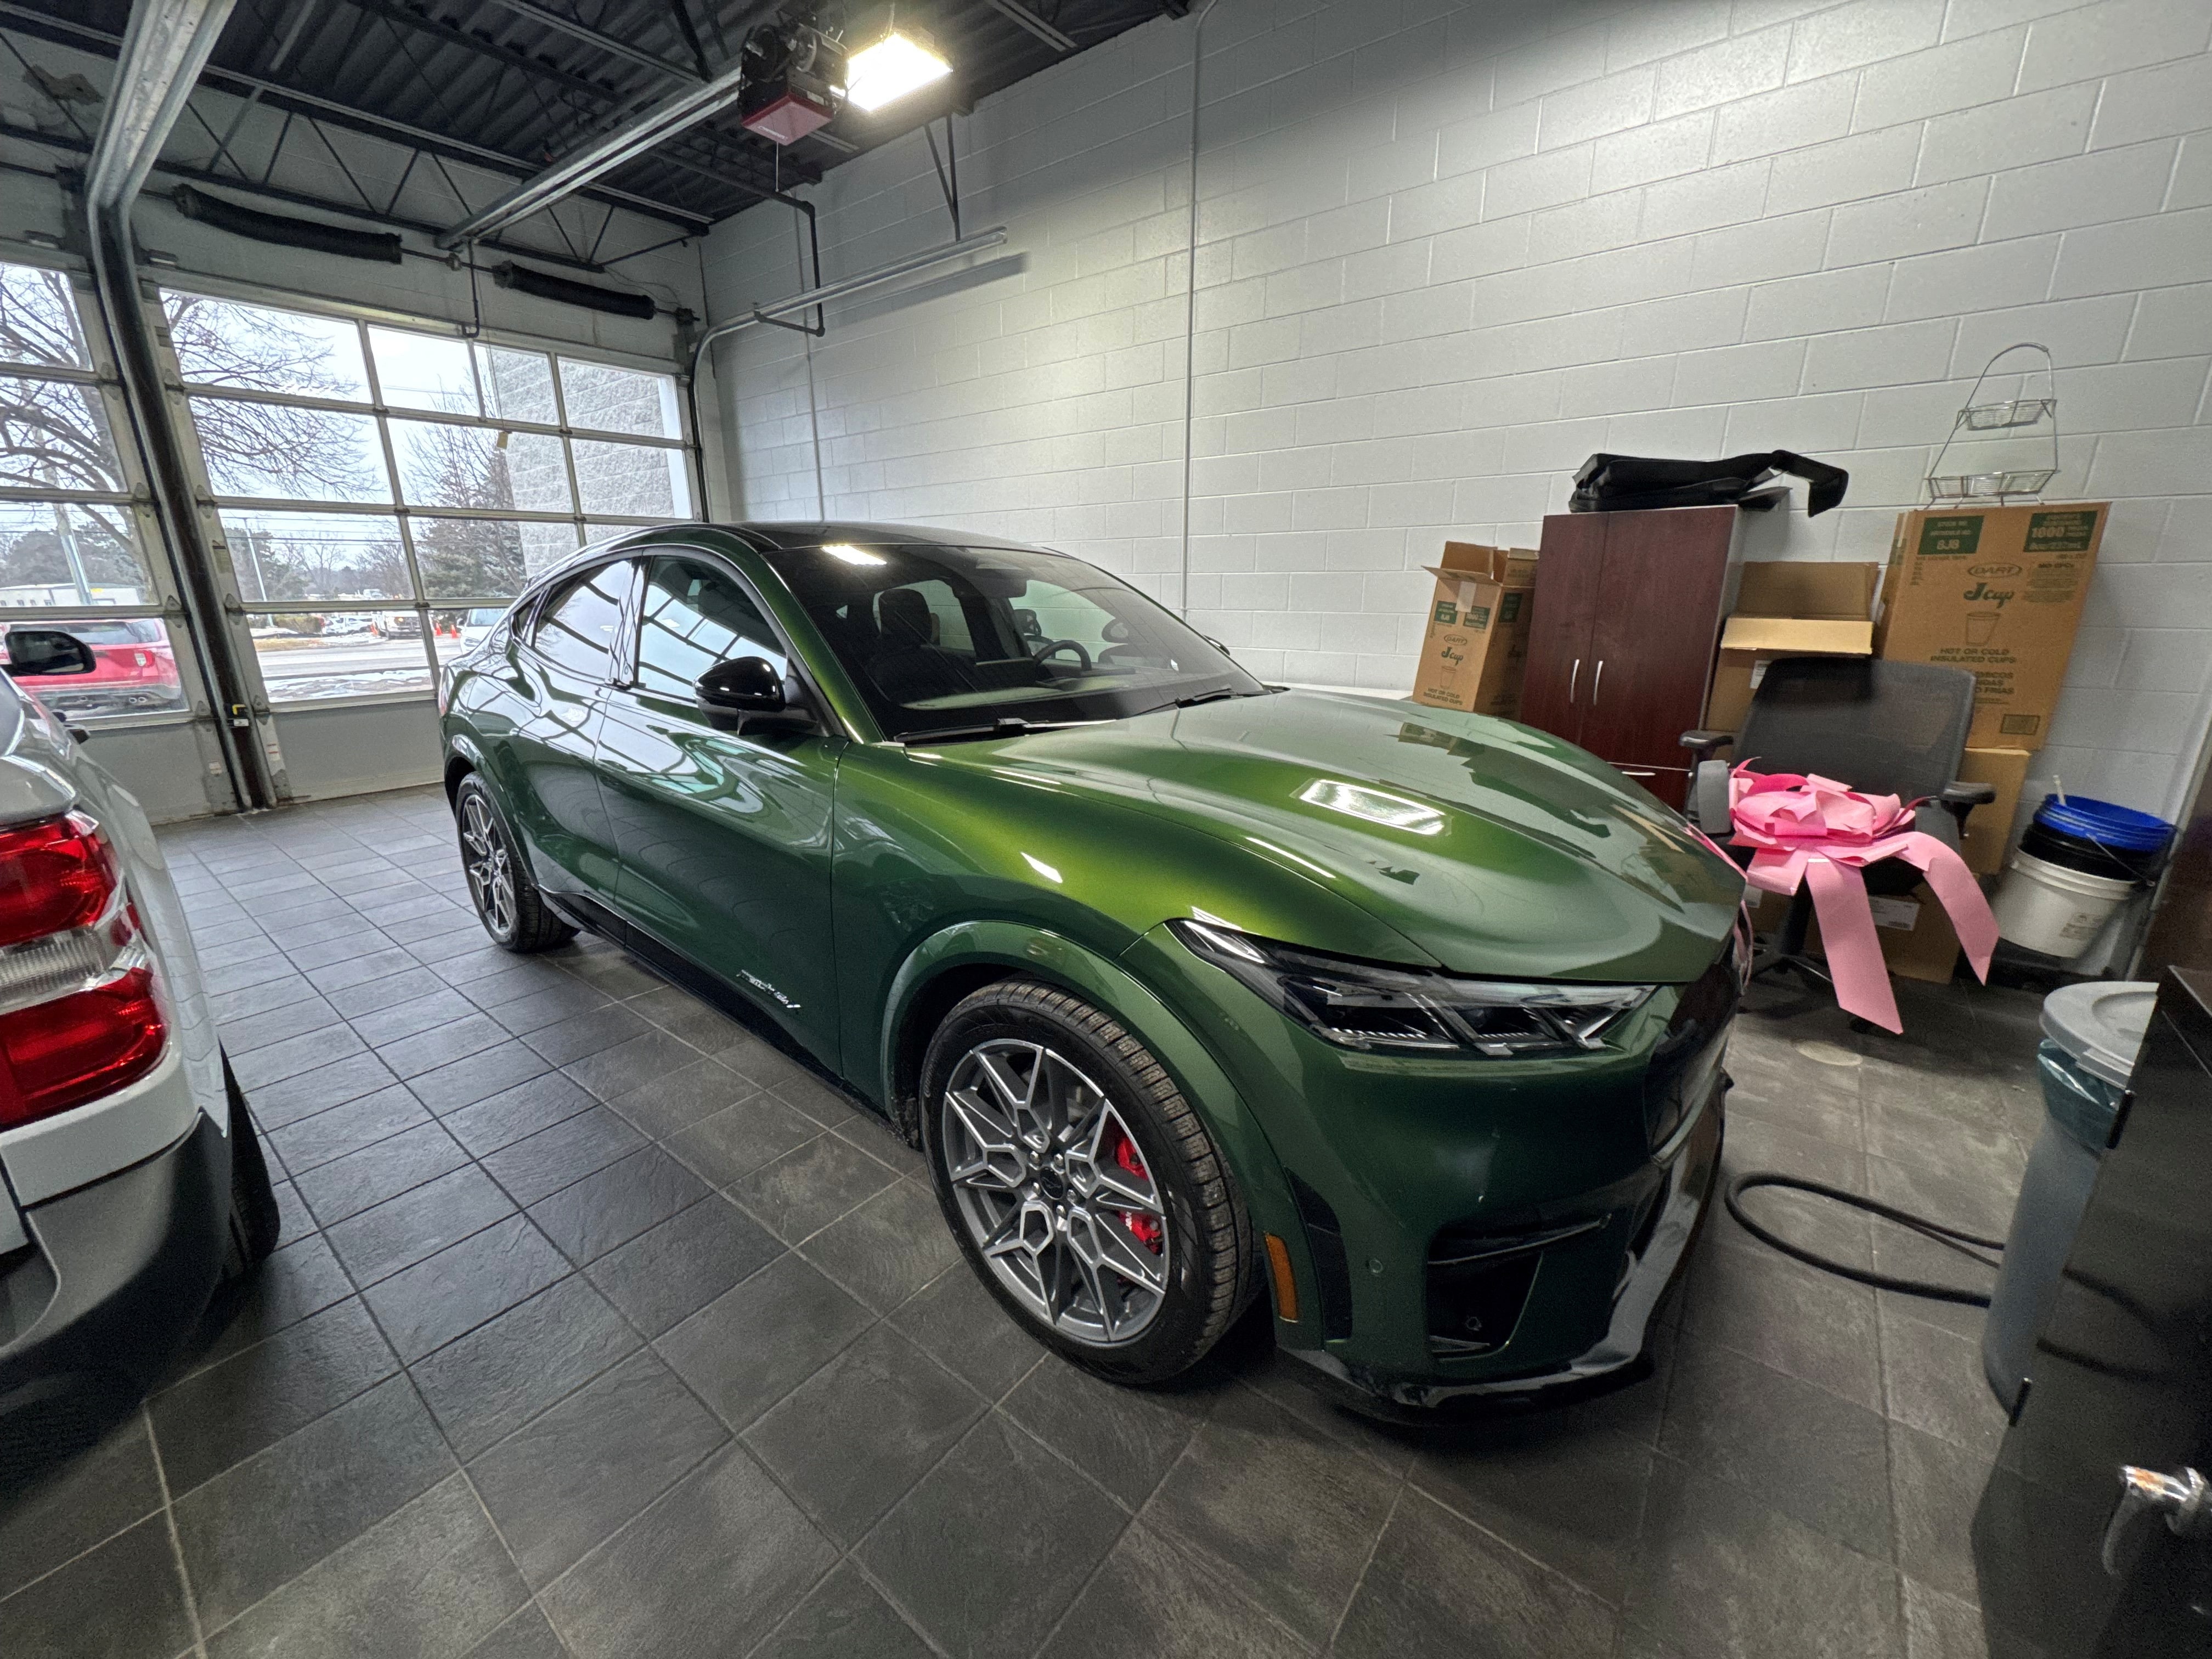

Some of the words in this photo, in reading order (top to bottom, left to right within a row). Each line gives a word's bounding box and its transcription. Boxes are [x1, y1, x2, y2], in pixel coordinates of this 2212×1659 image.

[2032, 526, 2065, 538] 1000
[1974, 566, 2015, 574] DART
[1446, 635, 1465, 644] DART
[1423, 691, 1448, 702] INSULATED
